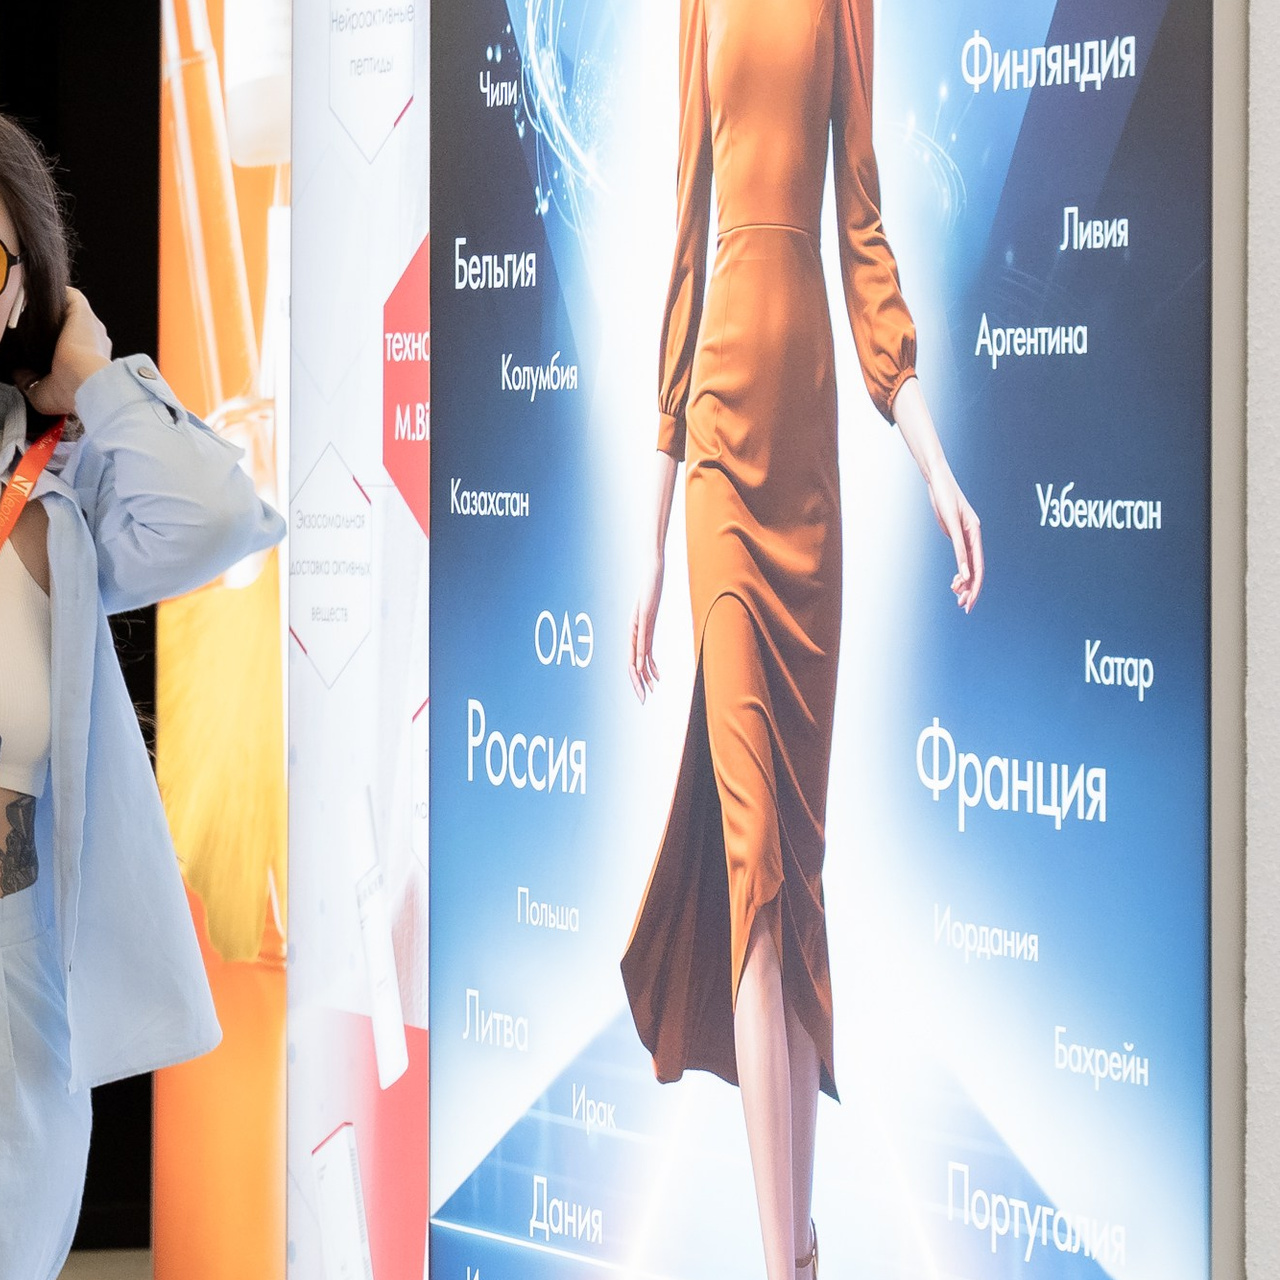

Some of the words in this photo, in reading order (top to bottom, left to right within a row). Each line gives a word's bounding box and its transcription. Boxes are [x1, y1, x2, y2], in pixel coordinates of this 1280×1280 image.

[479, 70, 517, 108] Чили
[961, 29, 1136, 95] Финляндия
[1061, 206, 1129, 252] Ливия
[454, 237, 536, 290] Бельгия
[976, 314, 1088, 369] Аргентина
[501, 353, 578, 403] Колумбия
[450, 477, 529, 518] Казахстан
[1035, 483, 1161, 531] Узбекистан
[534, 611, 594, 668] ОАЭ
[1085, 640, 1154, 702] Катар
[467, 699, 587, 795] Россия
[916, 717, 1107, 832] Франция
[517, 887, 579, 933] Польша
[933, 904, 1039, 963] Иордания
[463, 987, 528, 1052] Литва
[1054, 1026, 1149, 1089] Бахрейн
[572, 1083, 615, 1132] Ирак
[530, 1175, 603, 1245] Дания
[948, 1161, 1126, 1266] Португалия
